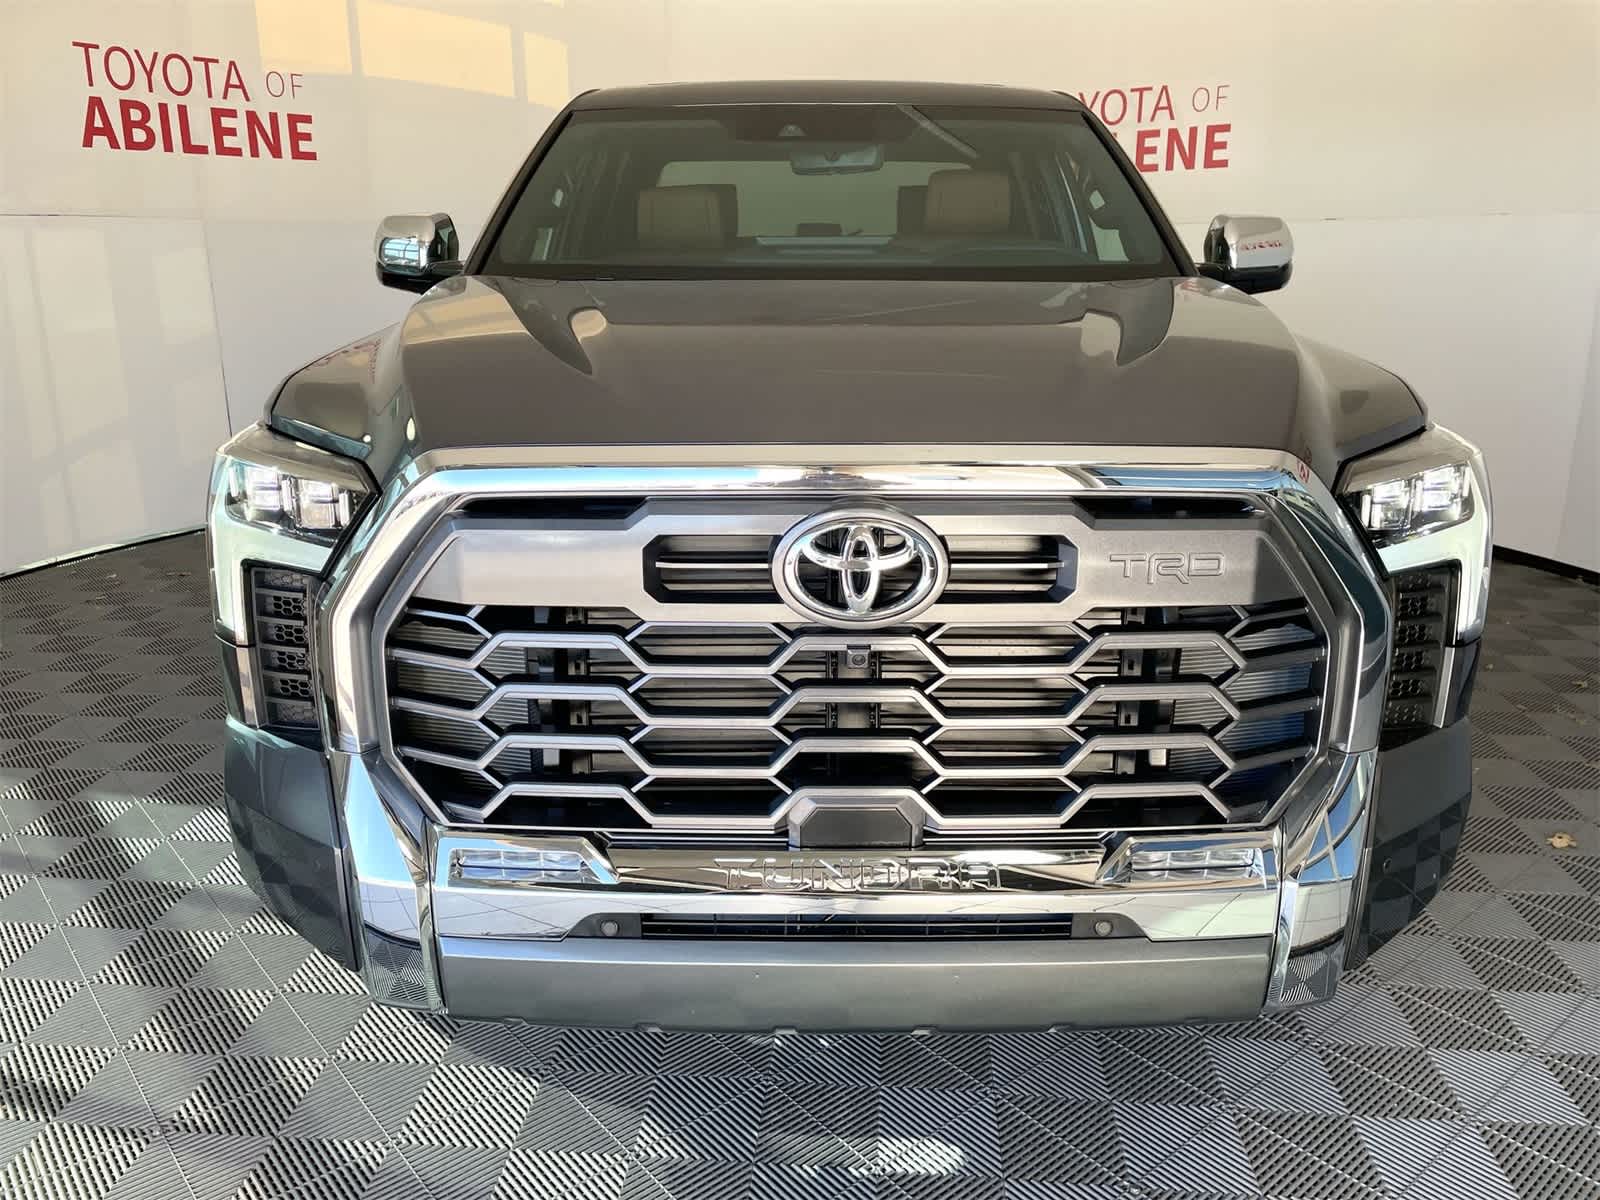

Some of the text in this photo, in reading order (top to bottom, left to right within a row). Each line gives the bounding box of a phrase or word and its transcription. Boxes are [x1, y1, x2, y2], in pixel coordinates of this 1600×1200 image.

[72, 41, 303, 102] TOYOTA OF
[1192, 85, 1231, 112] OF
[82, 95, 318, 161] ABILENE
[1113, 123, 1232, 173] ENE
[1110, 552, 1225, 584] TRD
[713, 857, 1001, 891] TUNDRA
